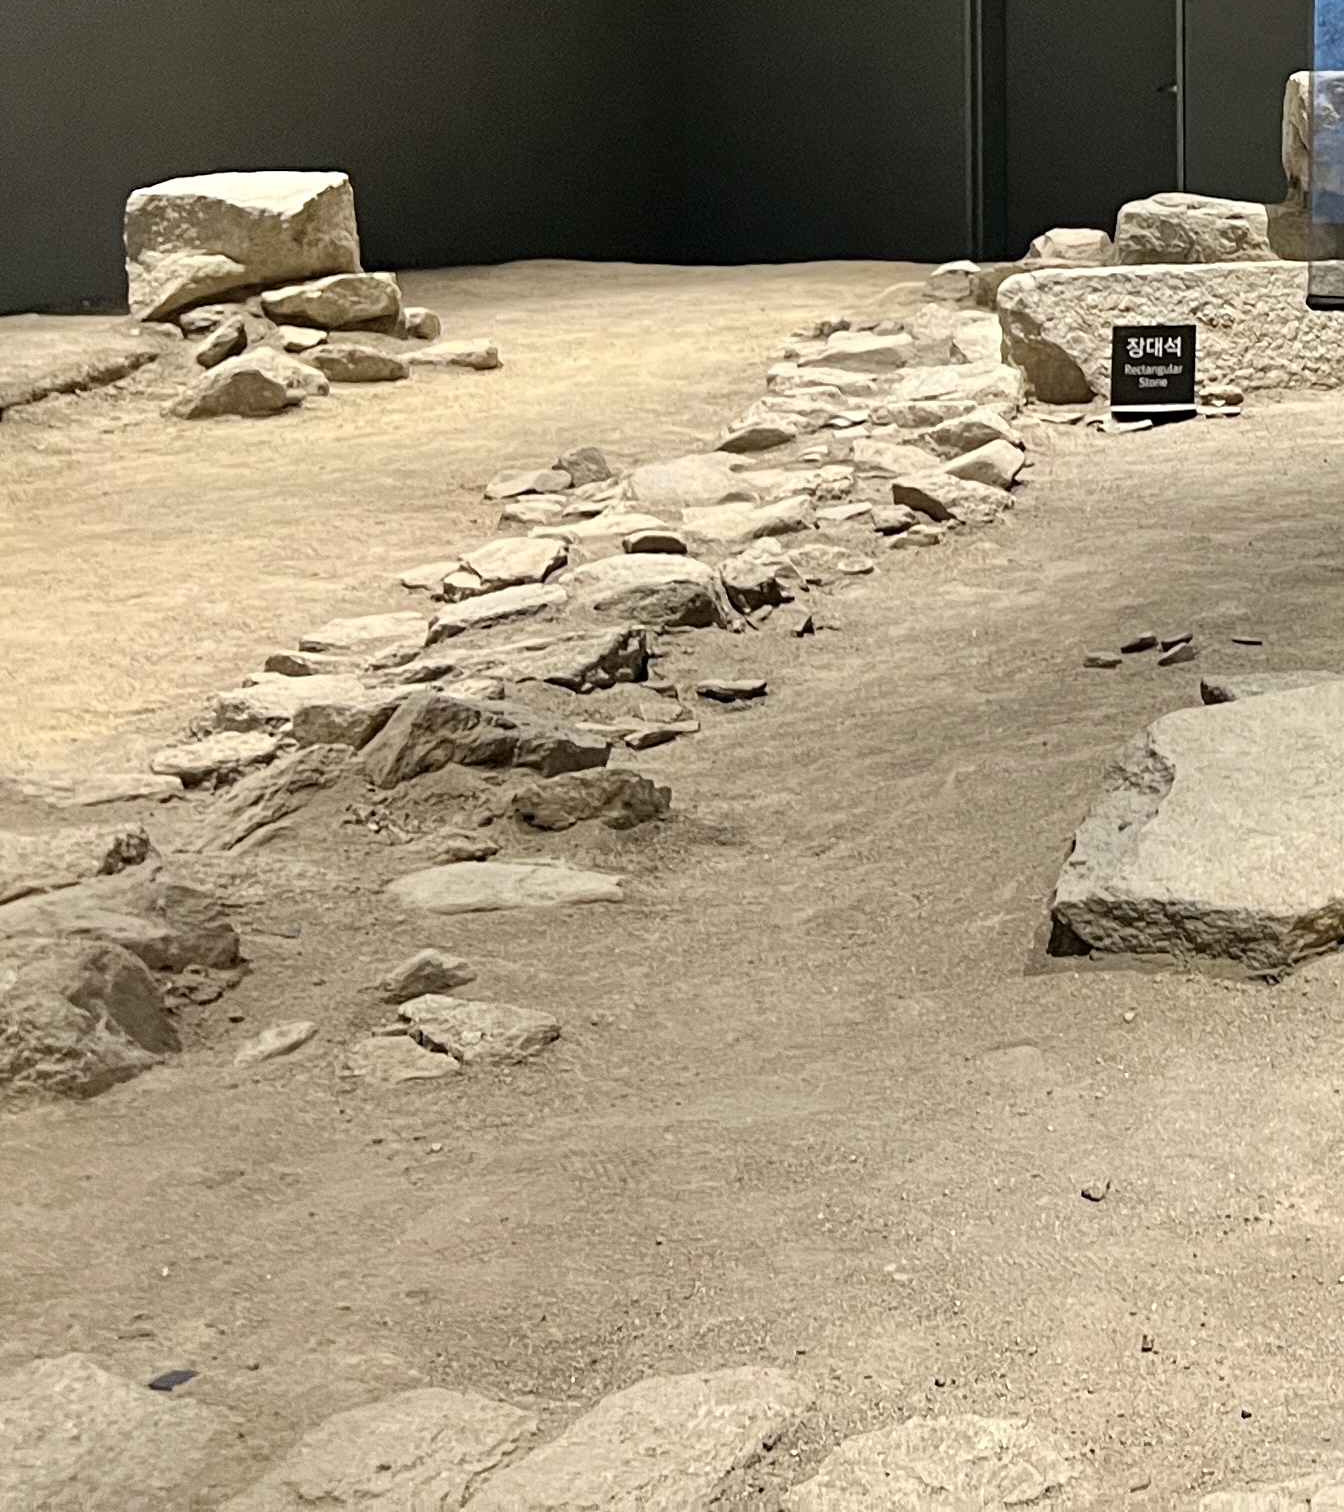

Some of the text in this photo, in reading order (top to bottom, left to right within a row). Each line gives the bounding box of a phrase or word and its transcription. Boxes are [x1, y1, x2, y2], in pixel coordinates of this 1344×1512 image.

[1126, 336, 1182, 358] 장대석
[1124, 363, 1183, 376] Rectangular
[1138, 376, 1168, 388] Stone
